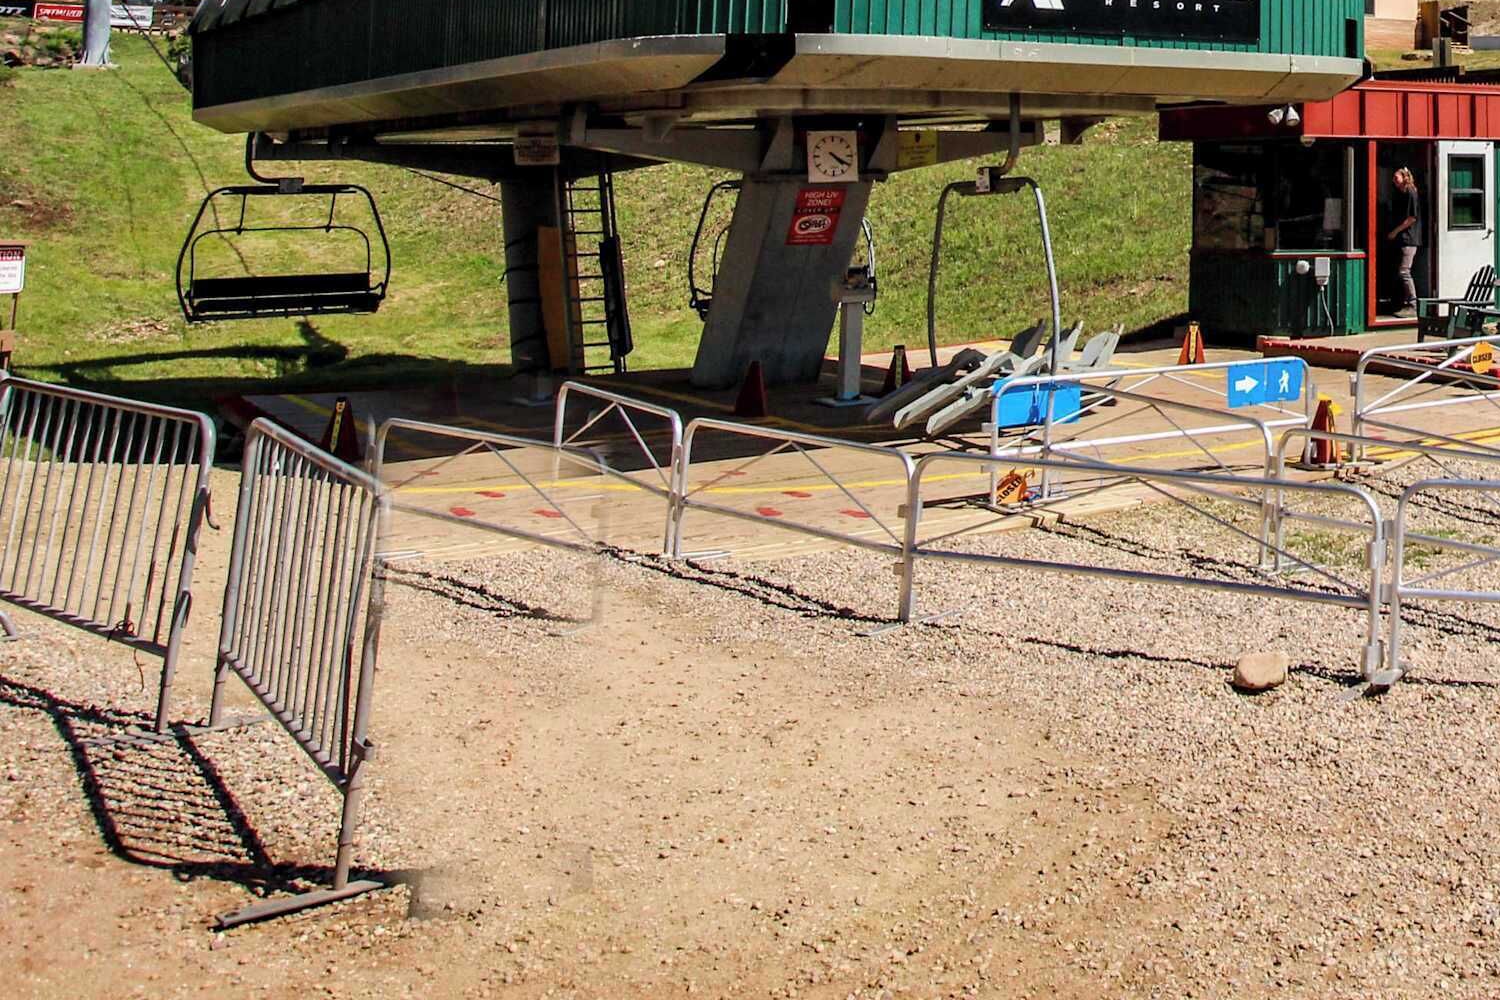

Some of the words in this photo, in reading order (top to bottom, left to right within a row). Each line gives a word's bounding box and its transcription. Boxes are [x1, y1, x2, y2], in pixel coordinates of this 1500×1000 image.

[804, 191, 825, 199] HIGH
[825, 191, 840, 200] UV
[807, 198, 833, 206] ZONE!
[1472, 352, 1493, 364] CLOSED
